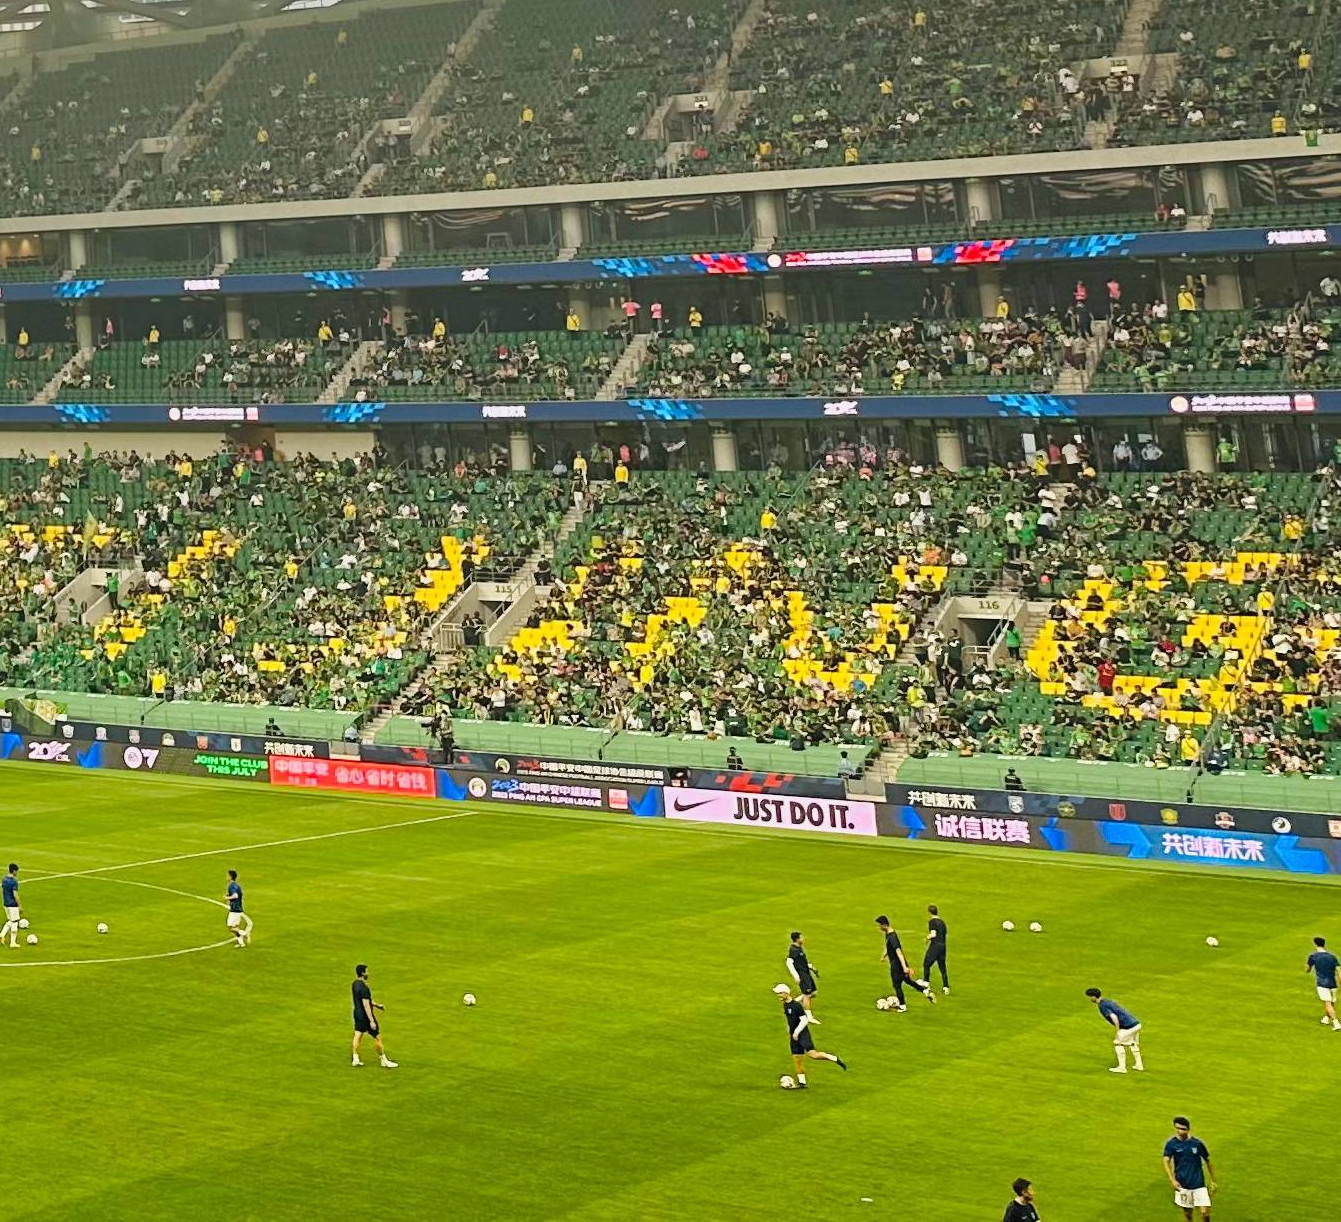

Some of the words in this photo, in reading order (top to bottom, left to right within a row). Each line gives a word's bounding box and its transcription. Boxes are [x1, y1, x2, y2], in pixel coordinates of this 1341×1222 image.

[495, 584, 512, 593] 115
[979, 600, 999, 610] 116
[194, 755, 218, 766] JOIN
[218, 757, 240, 767] THE
[241, 759, 268, 770] CLUB
[208, 764, 231, 775] THIS
[232, 766, 258, 777] JULY
[508, 792, 526, 801] PING
[551, 795, 573, 804] SUPER
[573, 797, 601, 807] LEAGUE
[907, 790, 977, 810] 共创新未来
[733, 796, 784, 823] JUST
[789, 801, 823, 827] DO
[829, 804, 855, 829] IT.
[934, 813, 1031, 844] 诚信联赛
[1161, 833, 1265, 862] 共创新未来
